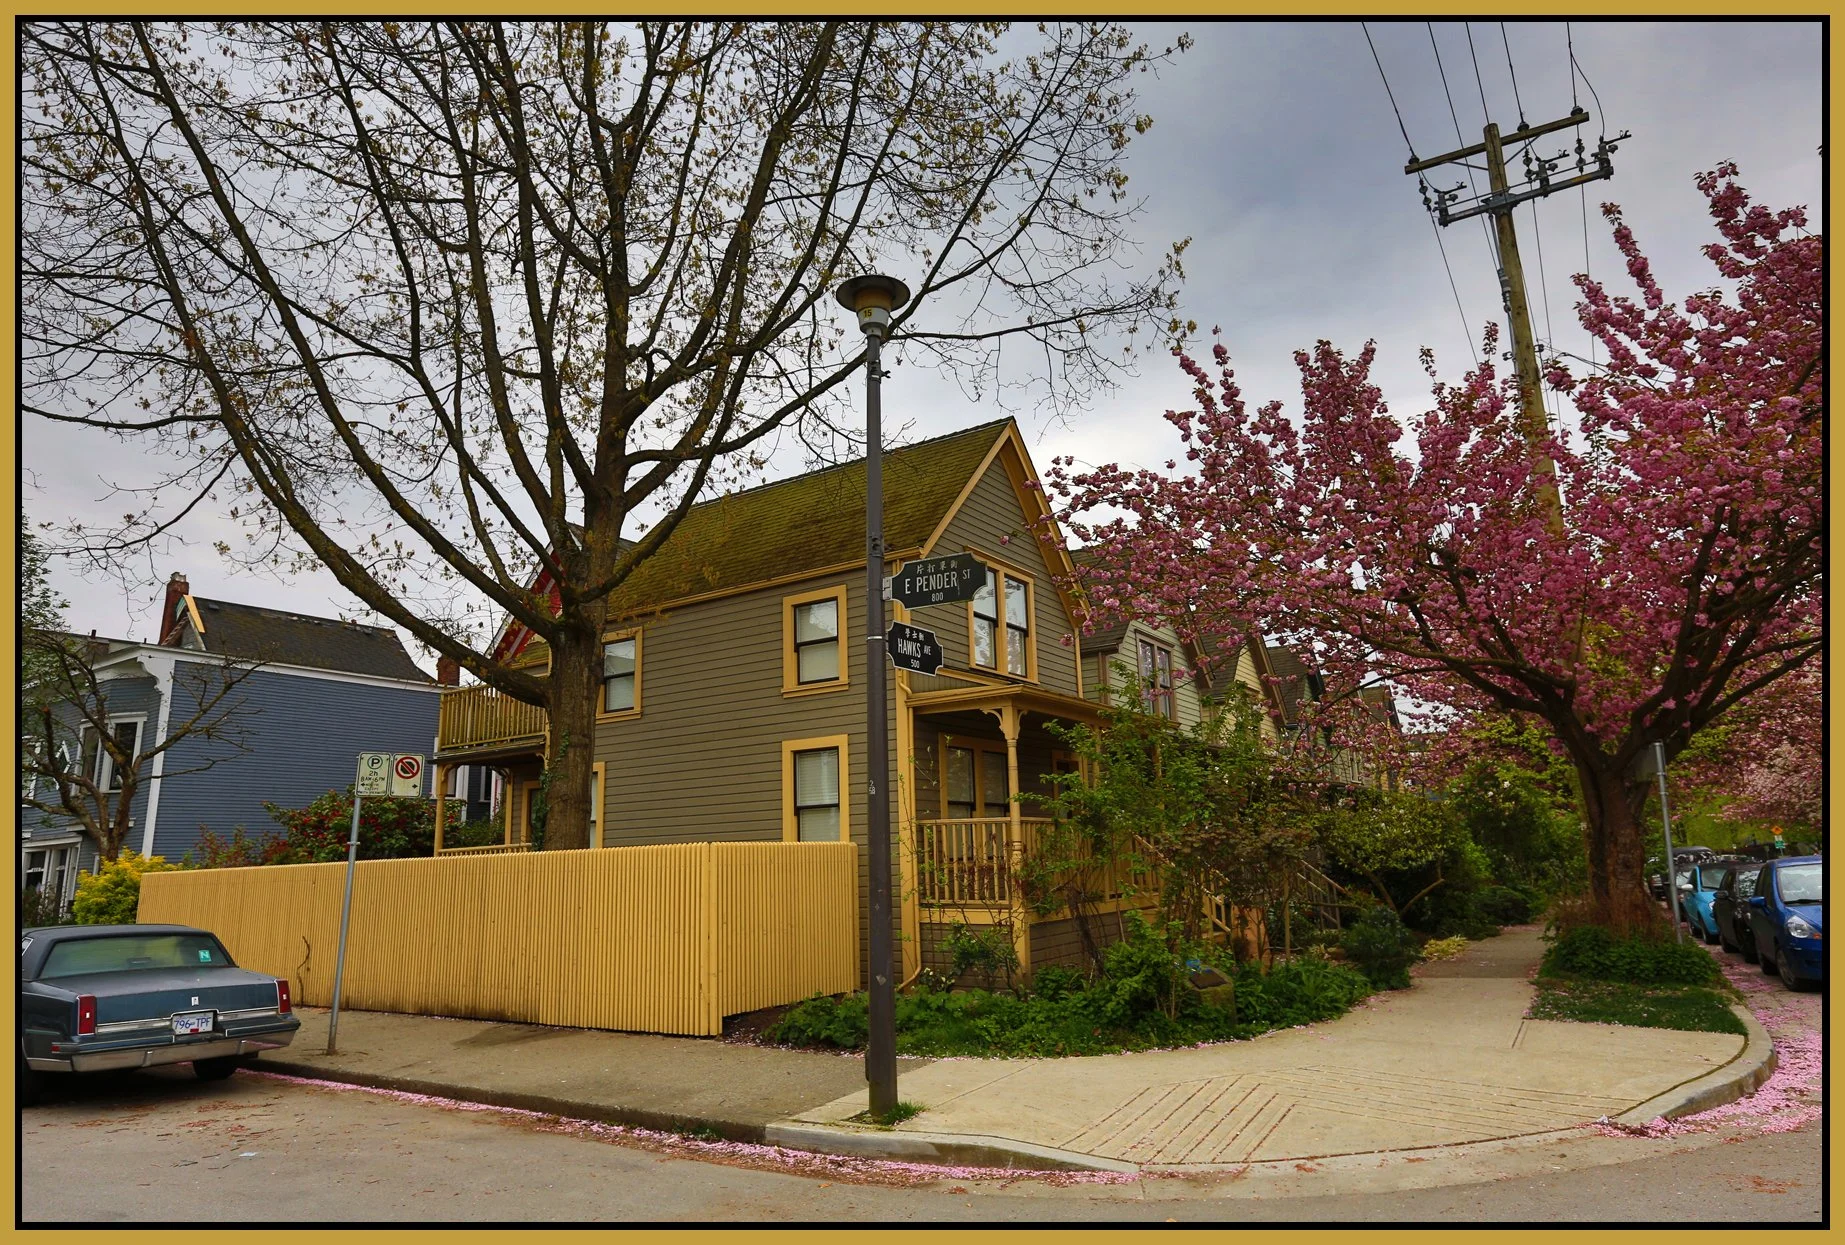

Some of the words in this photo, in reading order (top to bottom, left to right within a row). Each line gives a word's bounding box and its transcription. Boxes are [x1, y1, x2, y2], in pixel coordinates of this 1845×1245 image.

[864, 309, 872, 317] 15
[905, 578, 911, 595] E
[916, 571, 958, 593] PENDER
[962, 568, 971, 580] ST
[931, 592, 944, 603] 800
[897, 638, 921, 658] HAWKS
[923, 644, 932, 656] AVE
[910, 660, 920, 669] 500
[371, 758, 380, 767] P
